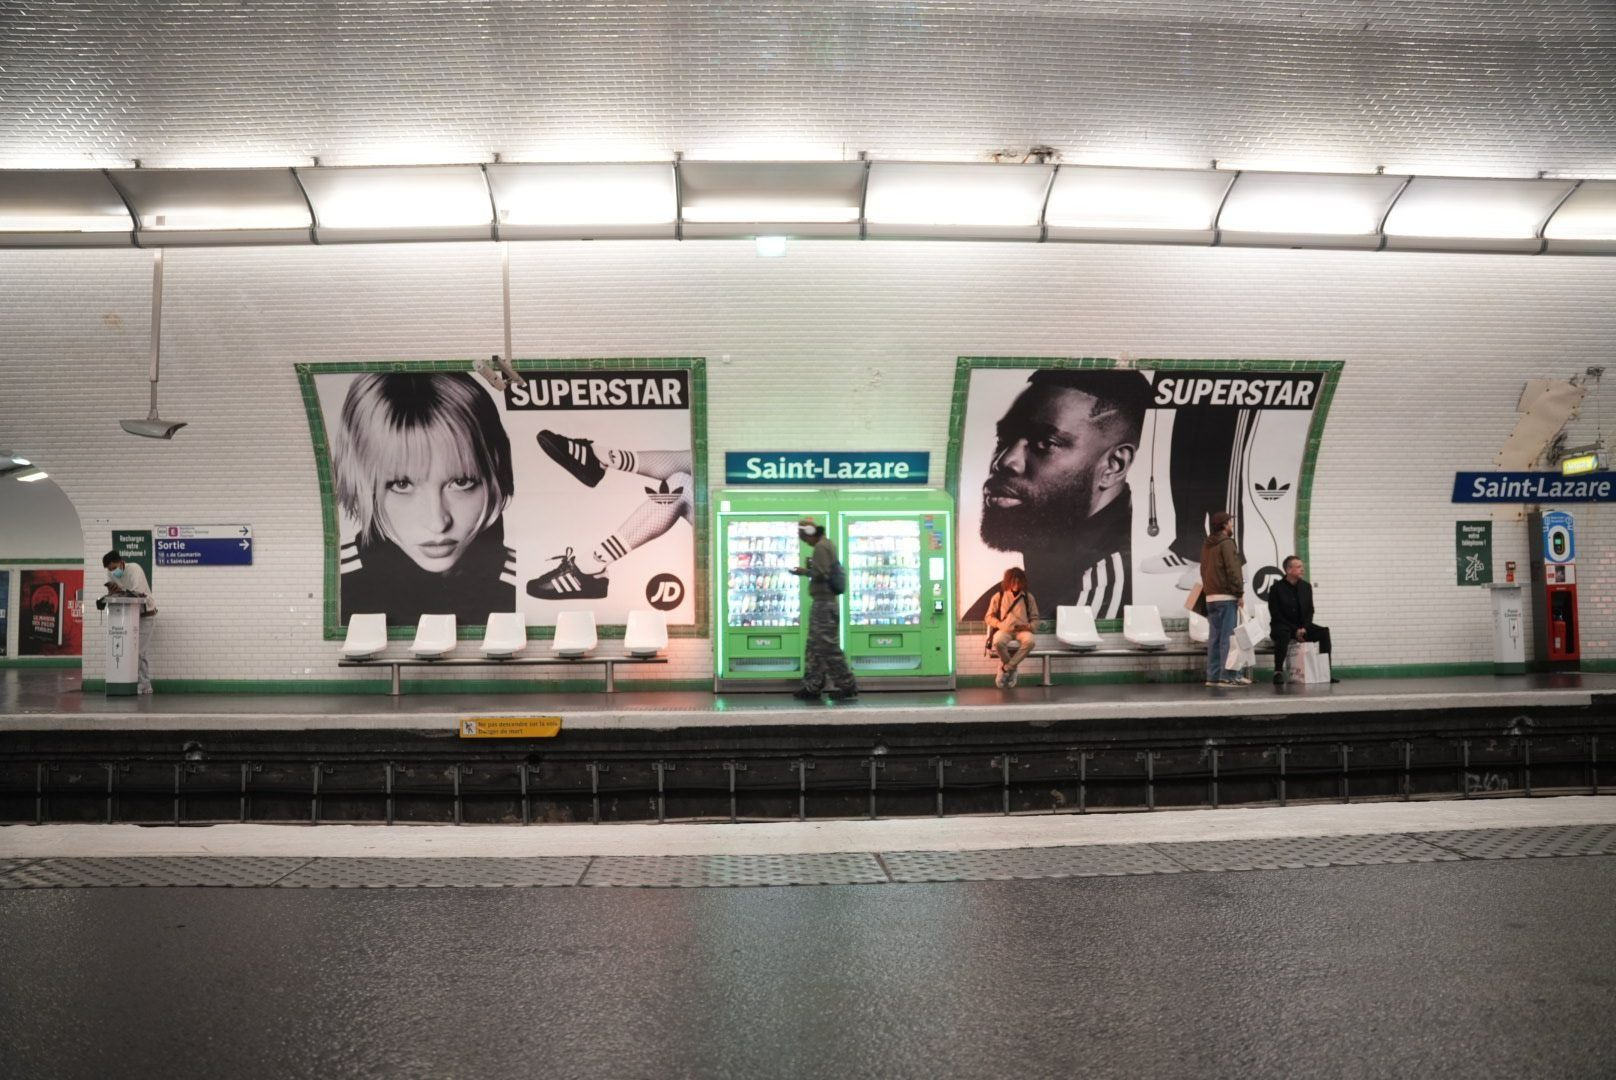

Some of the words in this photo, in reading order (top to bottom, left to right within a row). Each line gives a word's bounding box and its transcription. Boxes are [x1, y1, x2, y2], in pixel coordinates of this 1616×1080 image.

[510, 379, 682, 406] SUPERSTAR
[1155, 378, 1315, 406] SUPERSTAR
[746, 457, 909, 479] Saint-Lazare
[1472, 477, 1611, 498] Saint-Lazare
[119, 534, 145, 543] Rechargez
[157, 540, 186, 550] Sortie
[651, 581, 681, 603] JD
